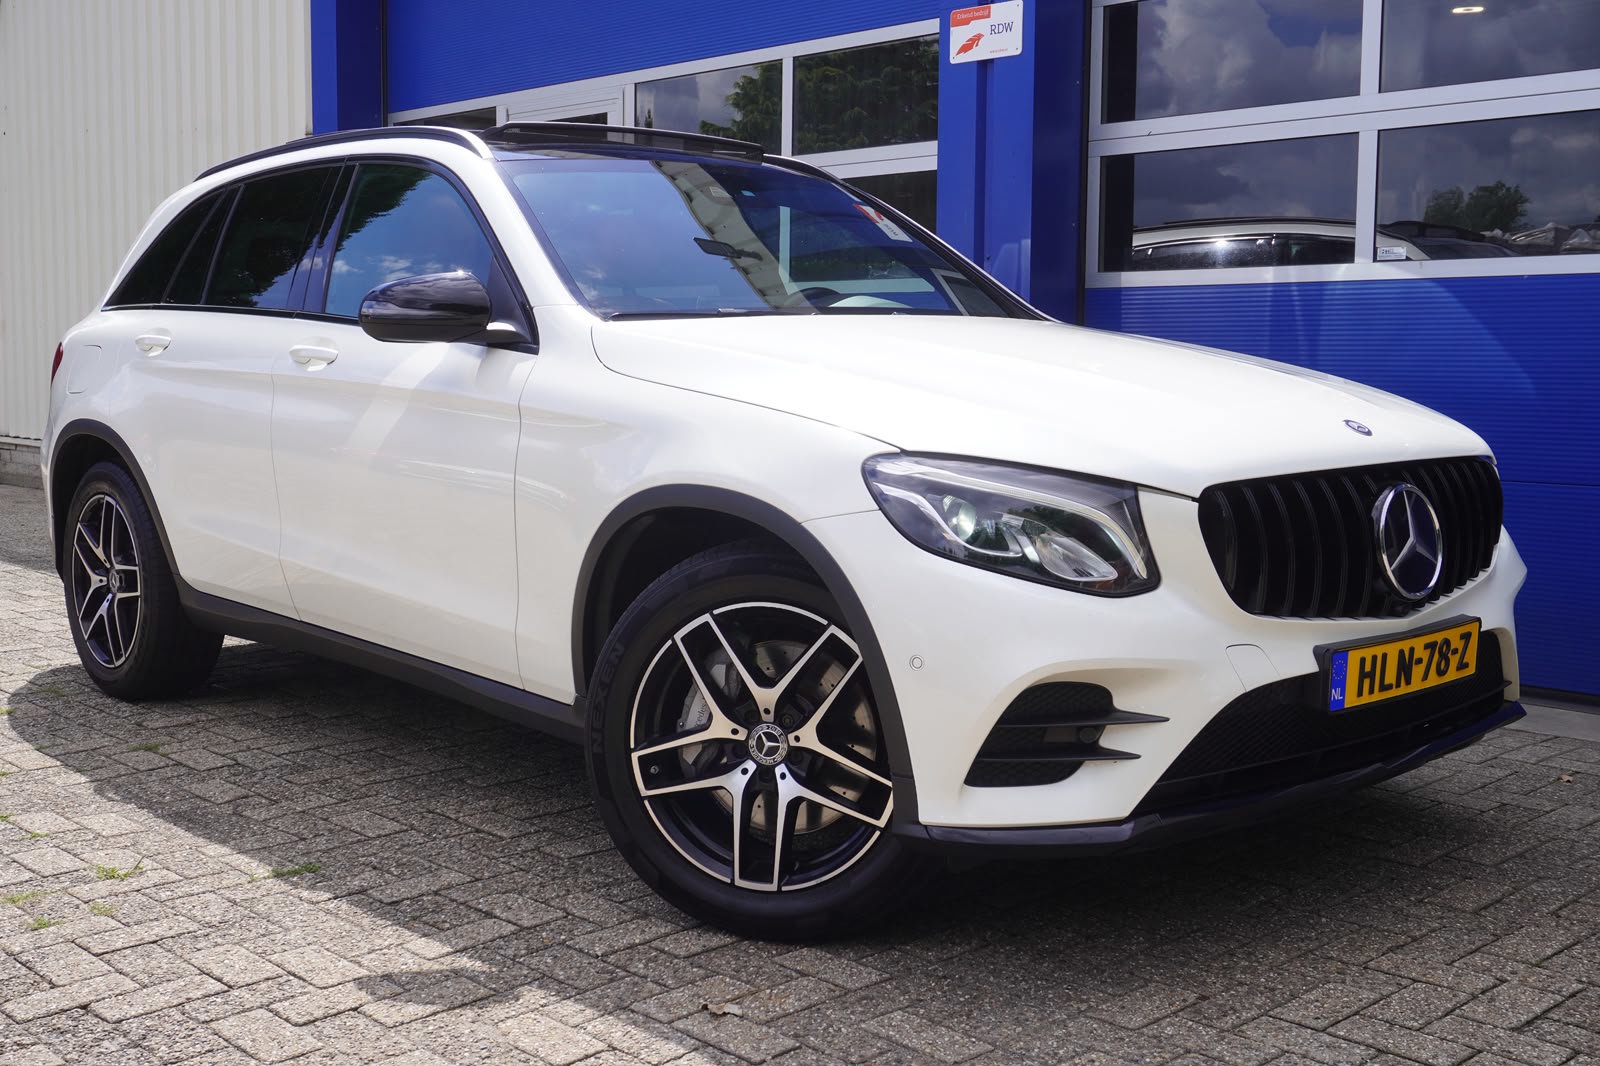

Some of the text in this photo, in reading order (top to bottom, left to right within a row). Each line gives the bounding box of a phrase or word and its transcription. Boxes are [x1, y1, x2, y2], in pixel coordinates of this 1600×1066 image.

[990, 21, 1014, 35] RDW
[1357, 631, 1472, 698] HLN-78-Z
[592, 643, 625, 754] NEXEN
[1331, 688, 1343, 701] NL
